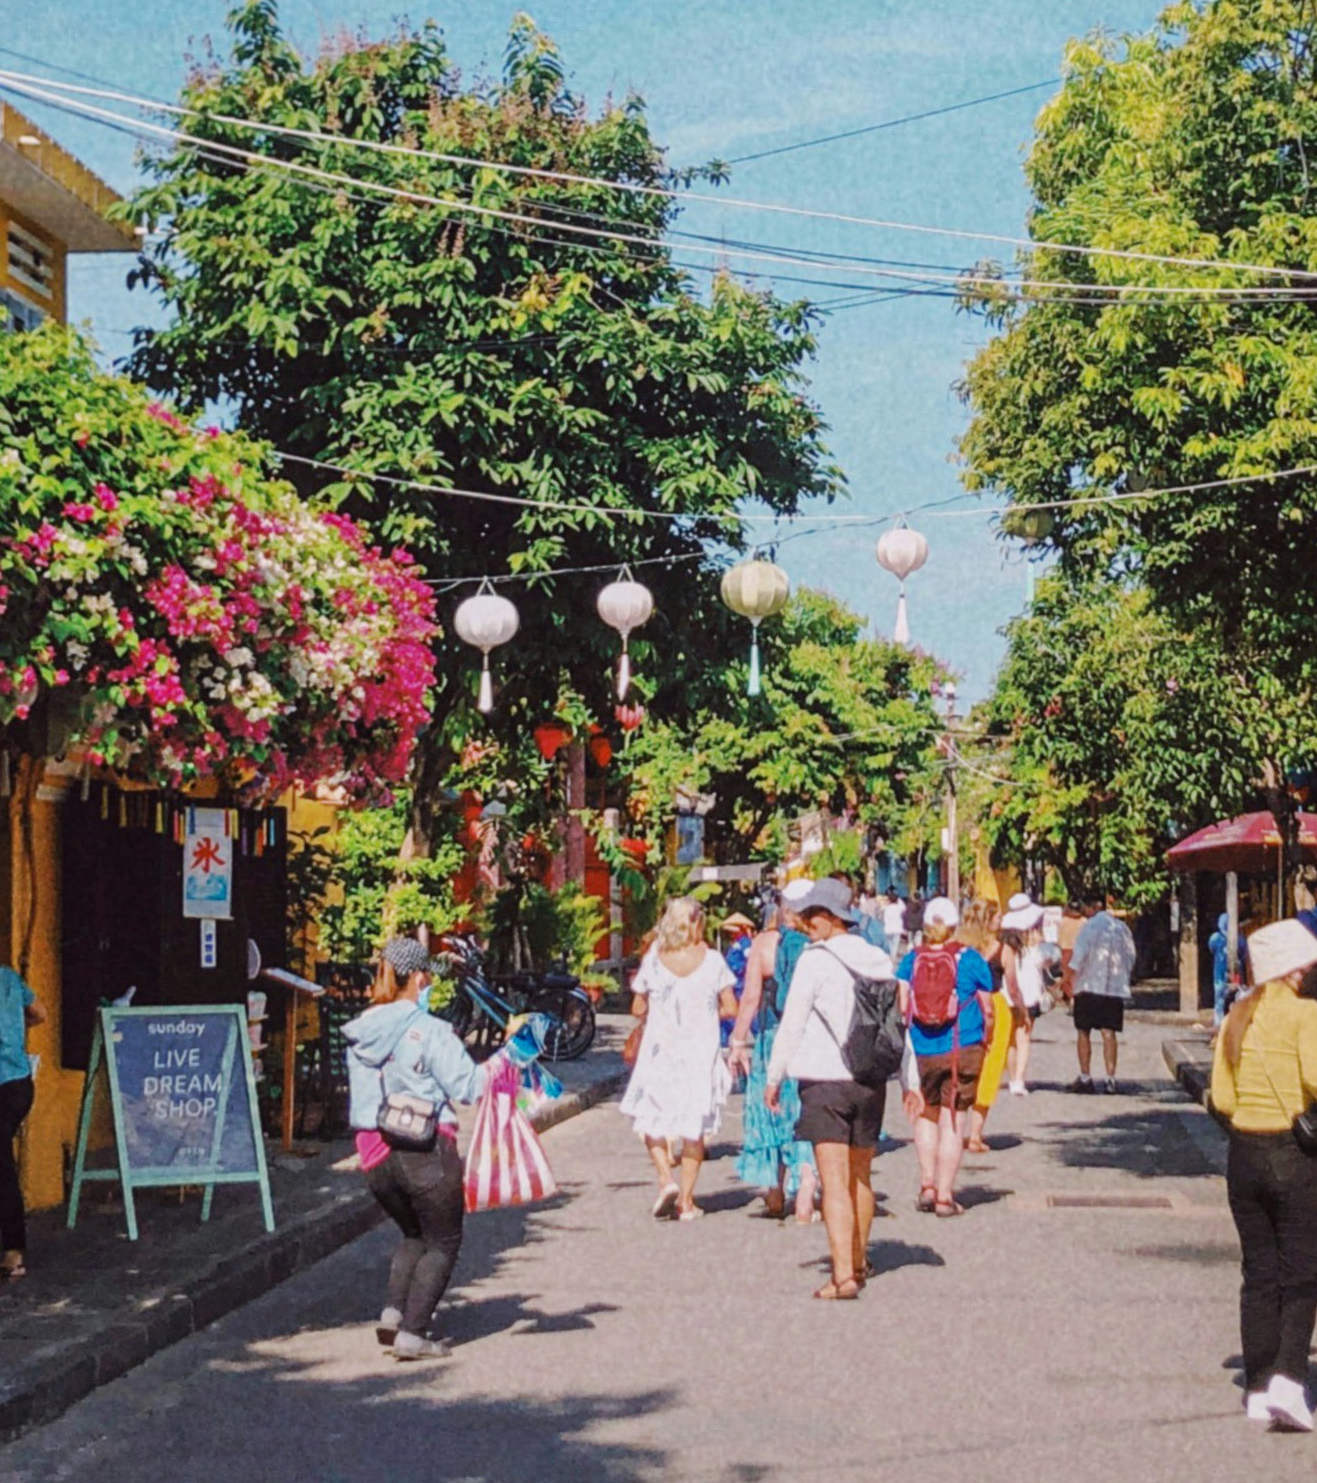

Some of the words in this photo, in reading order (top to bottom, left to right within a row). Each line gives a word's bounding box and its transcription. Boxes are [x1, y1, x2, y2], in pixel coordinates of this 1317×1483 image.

[190, 837, 226, 873] 氷
[147, 1020, 206, 1037] sunday
[154, 1048, 201, 1069] LIVE
[143, 1073, 222, 1096] DREAM
